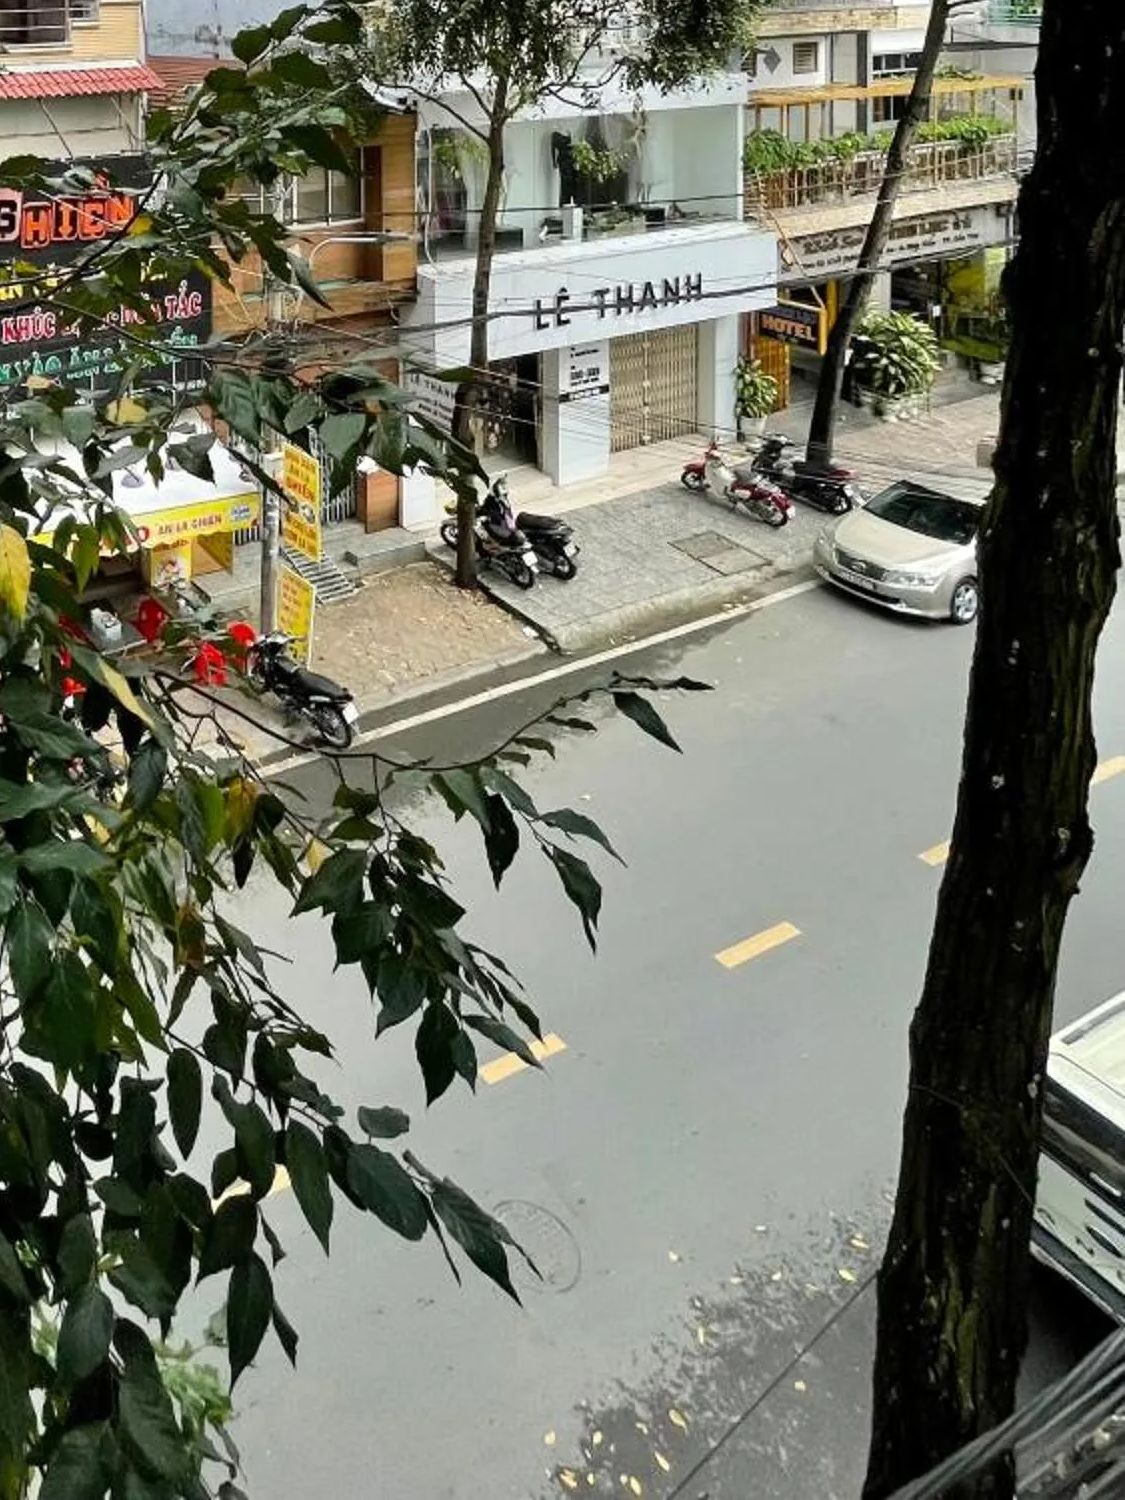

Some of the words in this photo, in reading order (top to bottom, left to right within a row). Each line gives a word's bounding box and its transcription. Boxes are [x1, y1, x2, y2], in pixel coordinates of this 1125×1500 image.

[536, 287, 571, 331] LÊ
[591, 272, 703, 320] THANH
[1, 305, 56, 345] KHÚC
[762, 313, 813, 341] HOTEL
